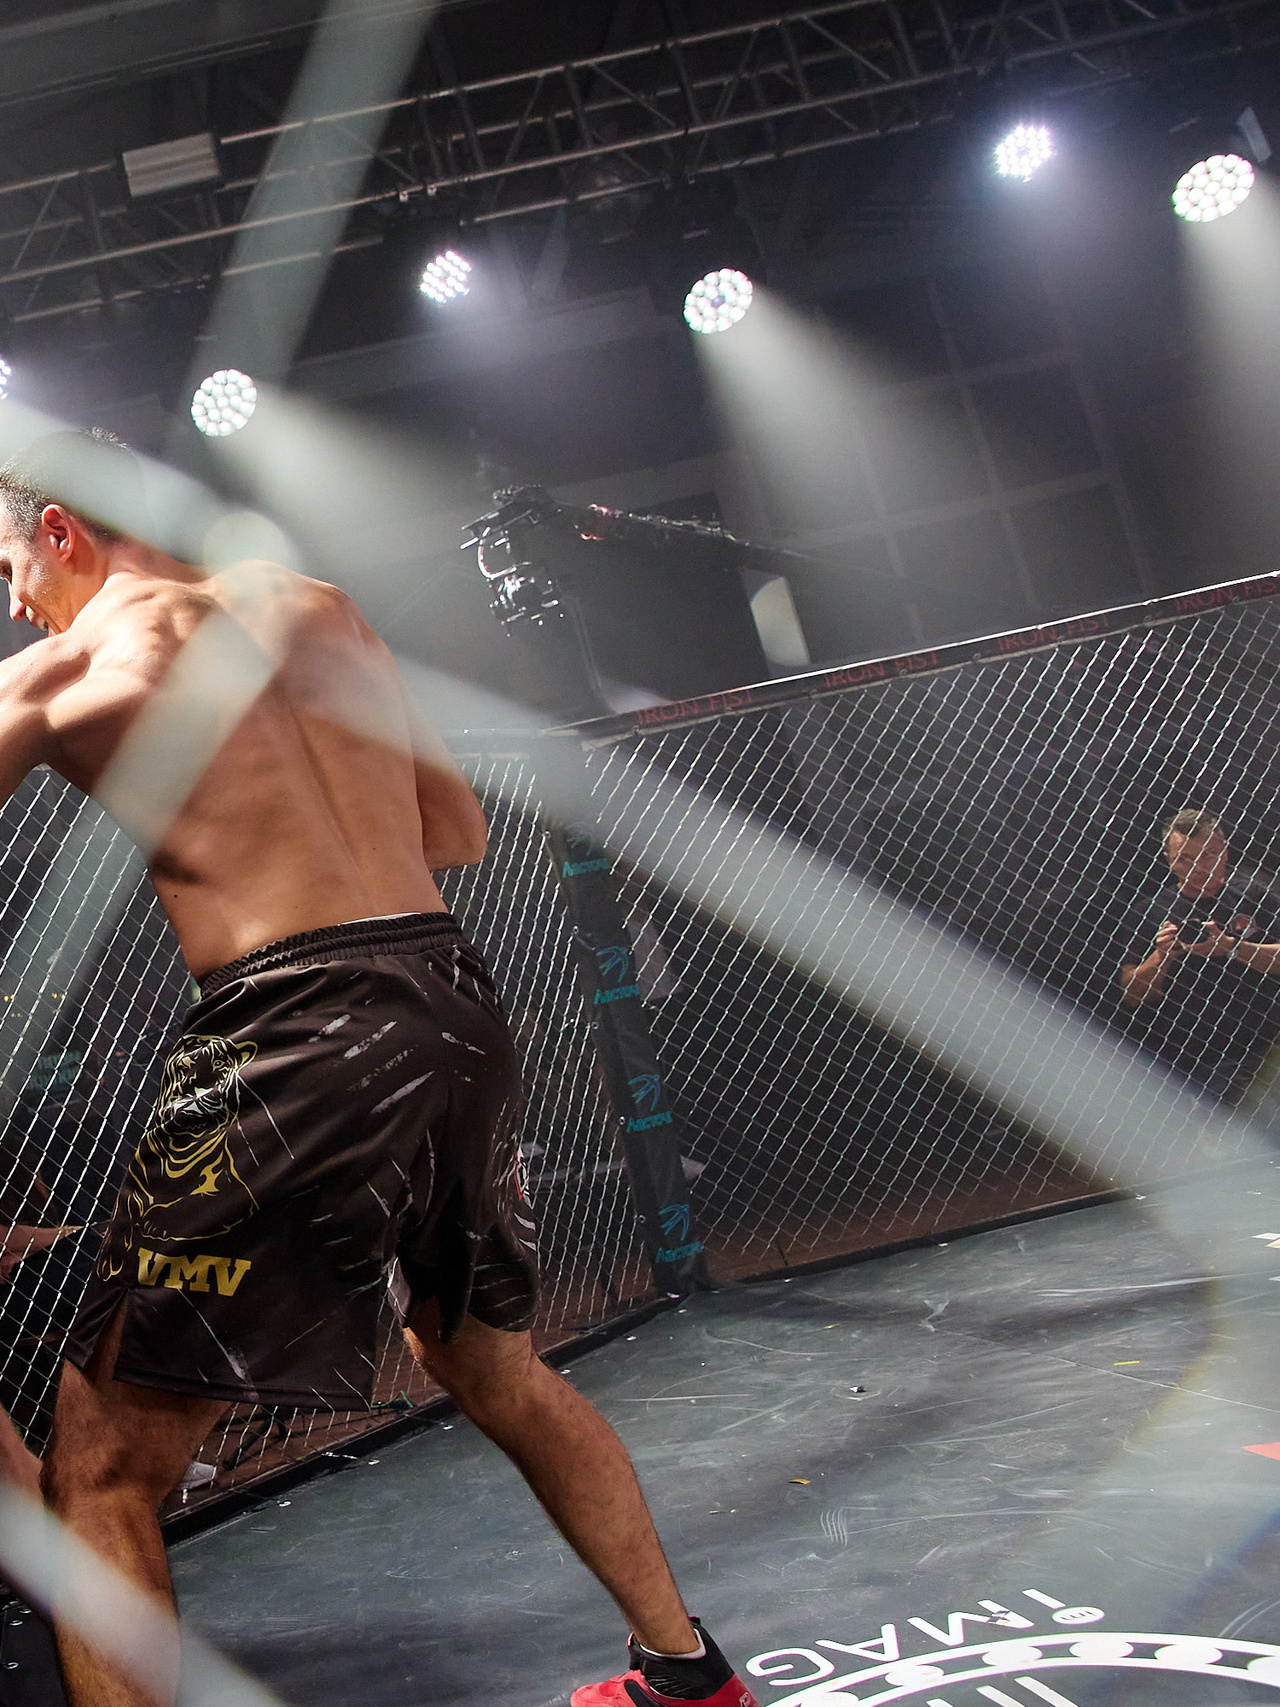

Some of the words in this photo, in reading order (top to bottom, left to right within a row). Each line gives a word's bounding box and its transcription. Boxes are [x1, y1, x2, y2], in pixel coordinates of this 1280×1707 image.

[1243, 580, 1278, 597] FIS
[998, 624, 1058, 651] IRON
[824, 661, 885, 688] IRON
[637, 700, 699, 724] IRON
[709, 689, 753, 712] FIST
[137, 1246, 252, 1297] VMV
